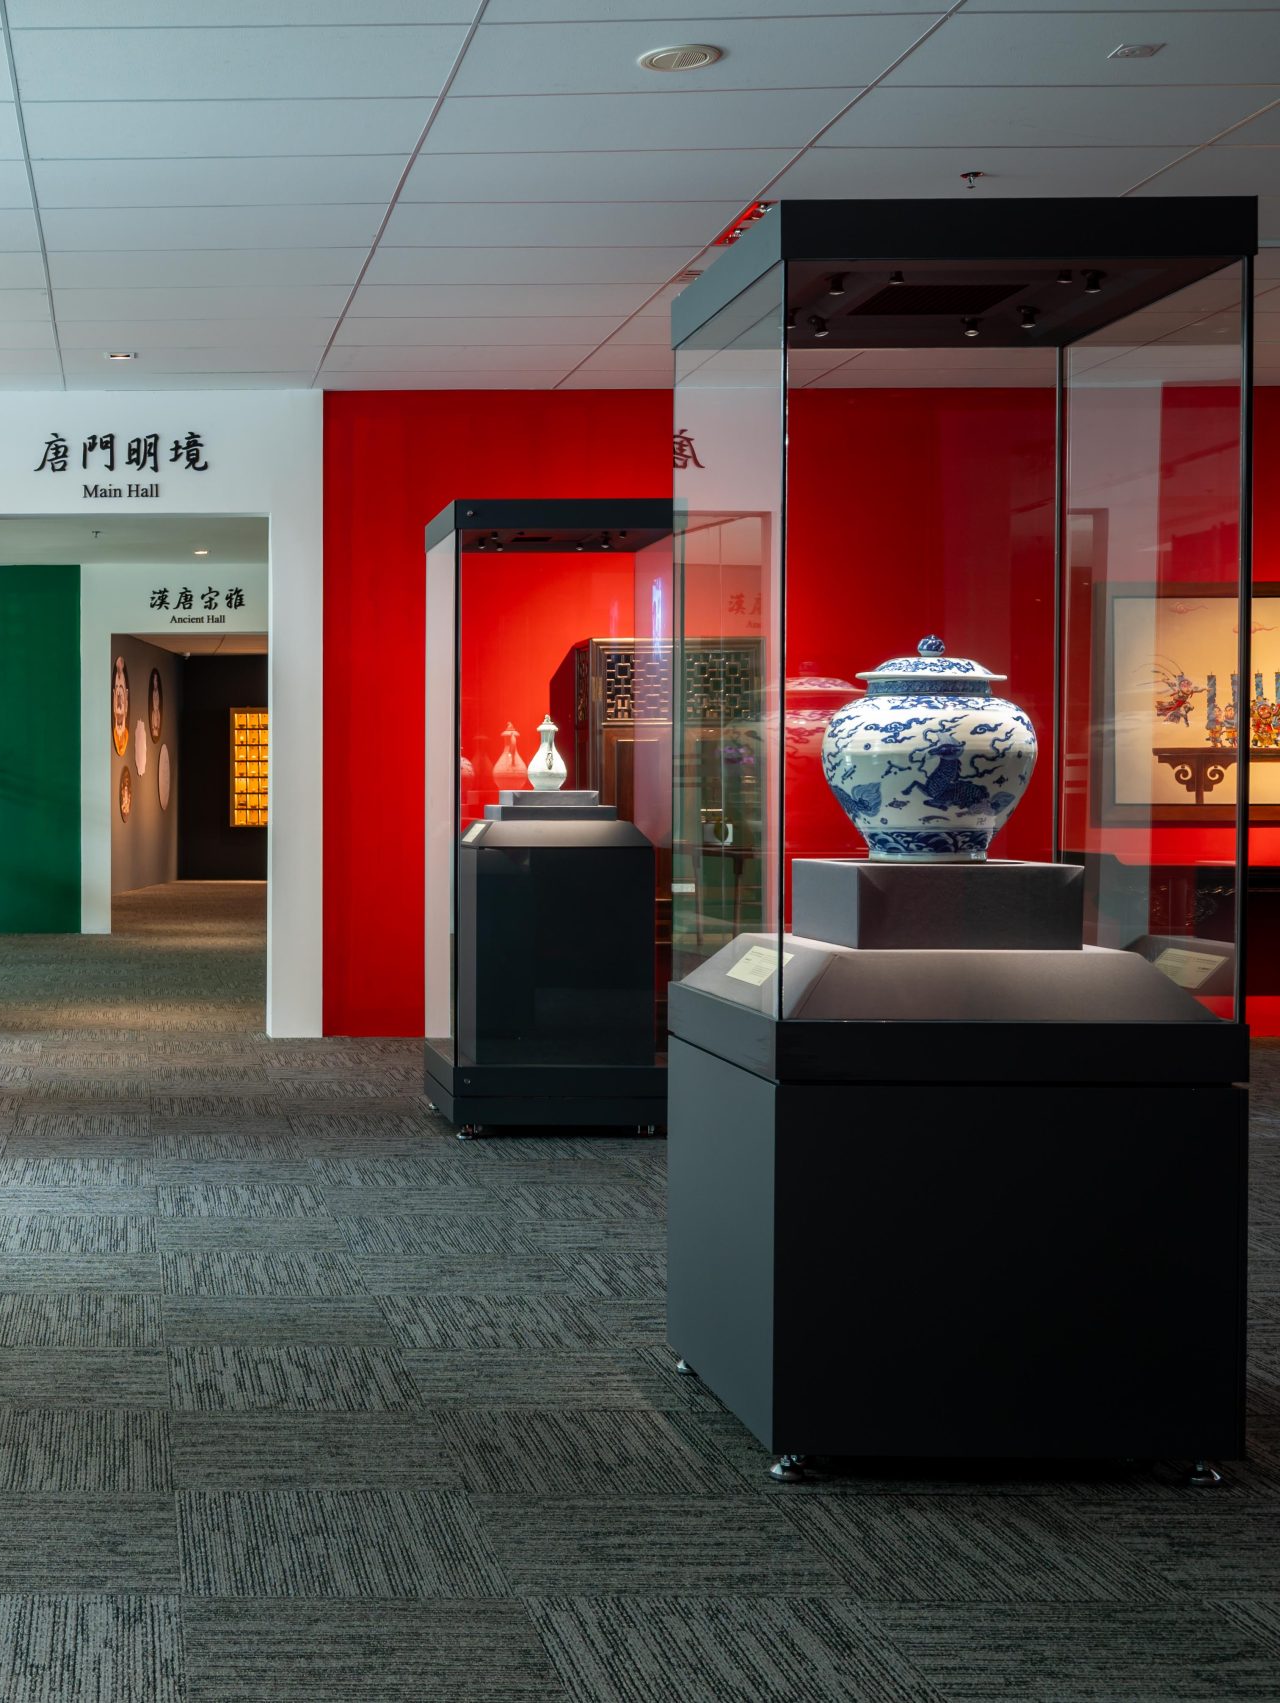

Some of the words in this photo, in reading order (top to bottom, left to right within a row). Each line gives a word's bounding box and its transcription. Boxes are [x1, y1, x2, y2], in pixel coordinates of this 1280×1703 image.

[34, 432, 208, 472] 唐門明境
[82, 484, 121, 498] Main
[127, 484, 159, 498] Hall
[150, 586, 245, 610] 漢唐宋雅
[170, 615, 204, 624] Ancient
[207, 615, 225, 623] Hall
